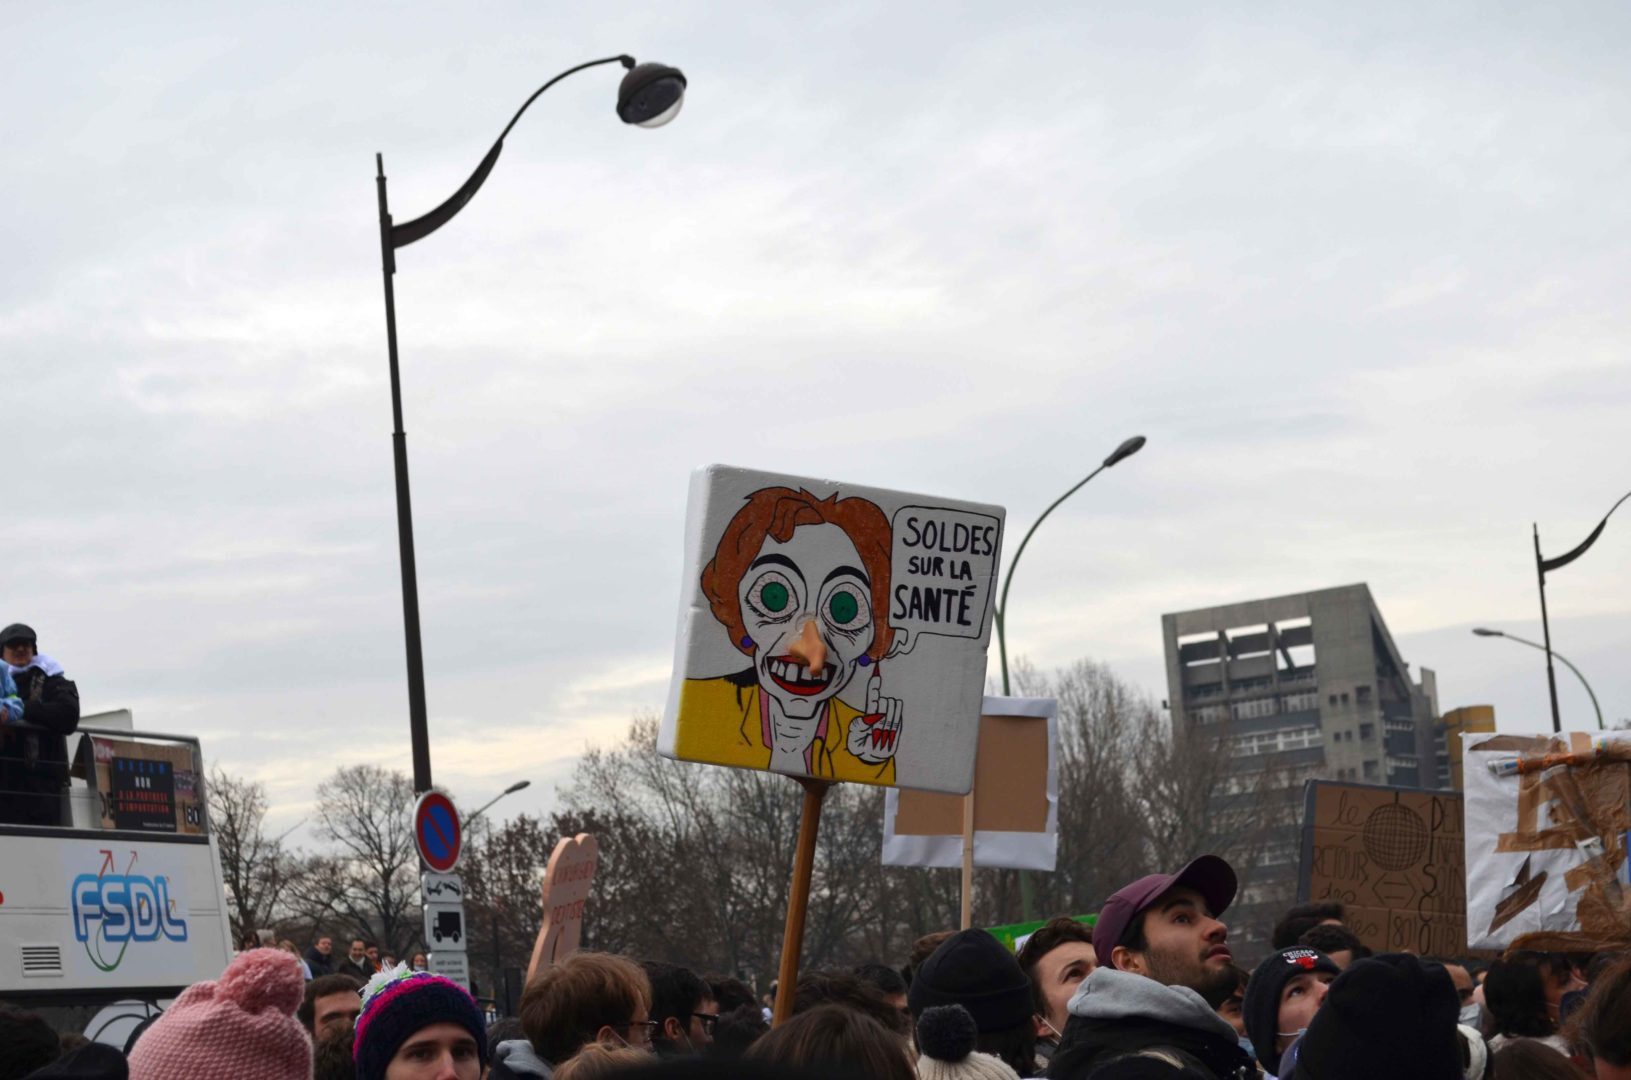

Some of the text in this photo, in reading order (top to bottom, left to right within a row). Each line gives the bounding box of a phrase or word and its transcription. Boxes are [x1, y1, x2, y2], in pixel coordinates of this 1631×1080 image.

[902, 517, 994, 556] SOLDES
[907, 556, 973, 581] SUR LA
[893, 584, 977, 626] SANTÉ
[72, 874, 188, 942] FSDL
